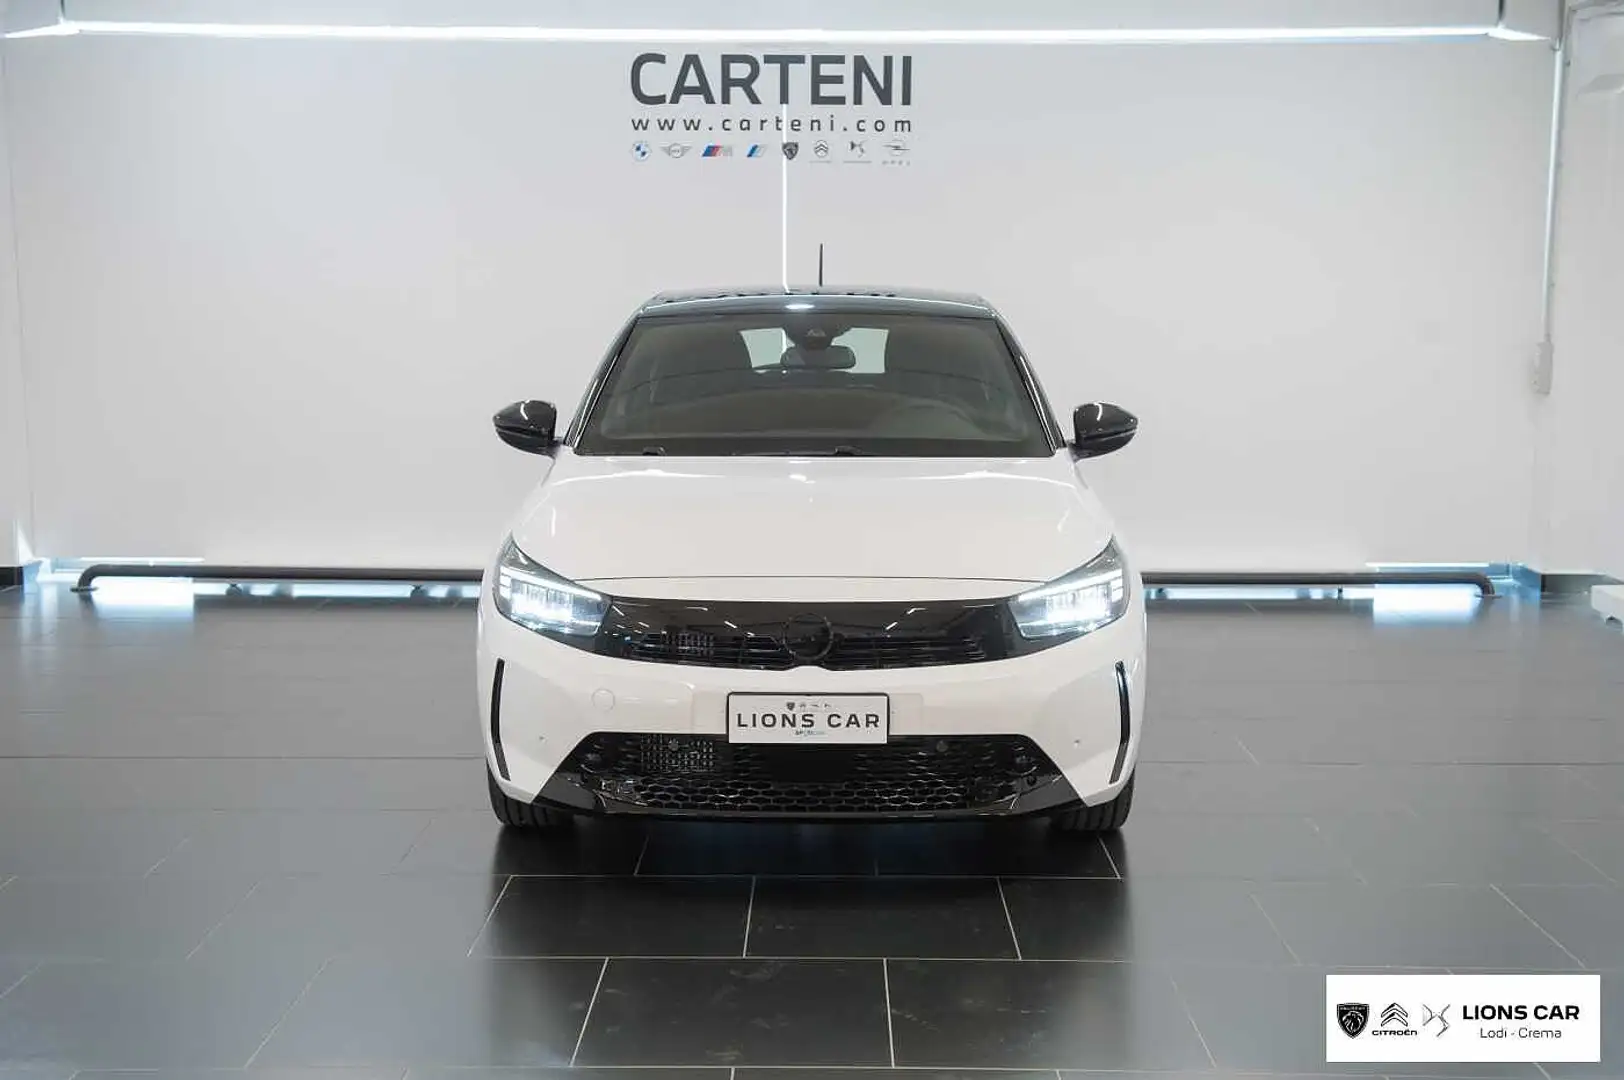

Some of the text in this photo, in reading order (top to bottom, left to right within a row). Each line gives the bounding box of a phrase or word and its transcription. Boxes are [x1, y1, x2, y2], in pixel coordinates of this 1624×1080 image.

[631, 53, 912, 106] CARTENI
[631, 114, 912, 133] www.carteni.com
[737, 713, 880, 729] LIONS CAR
